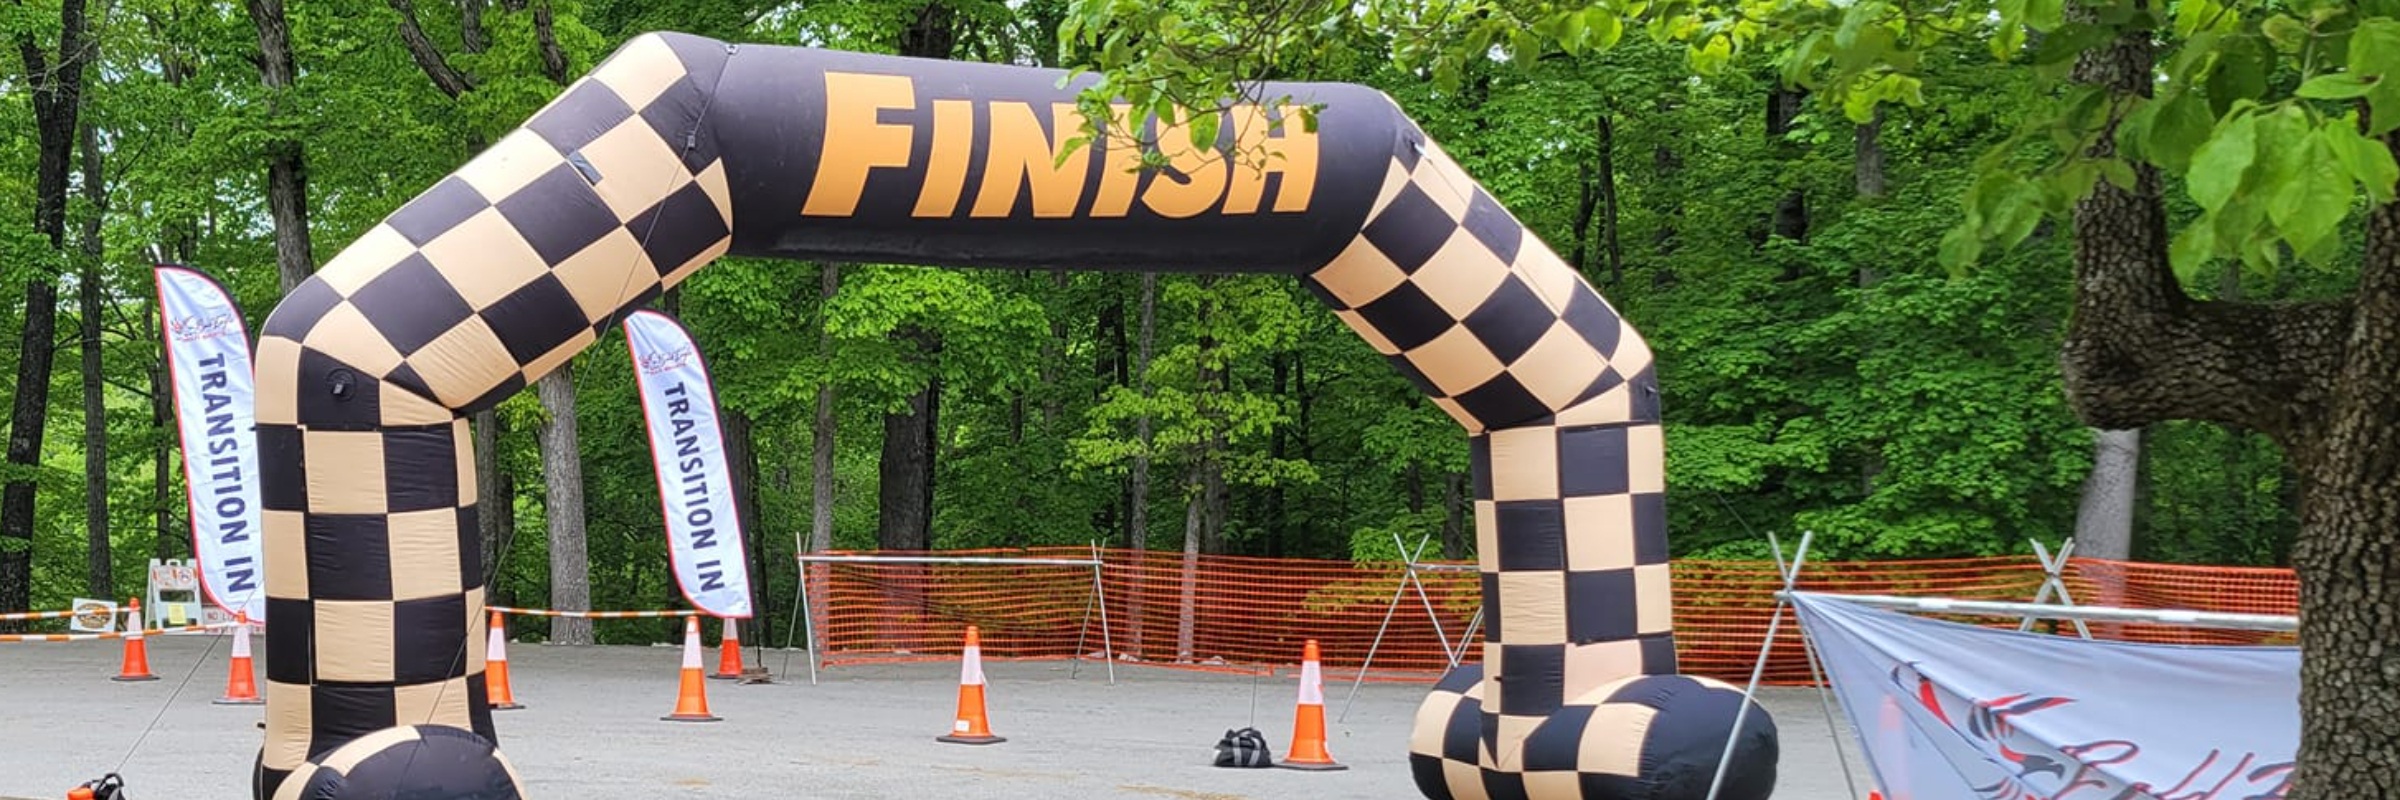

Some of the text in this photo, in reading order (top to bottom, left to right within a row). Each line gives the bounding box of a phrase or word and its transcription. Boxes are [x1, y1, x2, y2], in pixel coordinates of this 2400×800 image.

[801, 71, 1320, 218] FINISH
[198, 352, 250, 544] TRANSITION
[664, 381, 718, 550] TRANSITION
[696, 559, 725, 593] IN
[223, 556, 256, 593] IN
